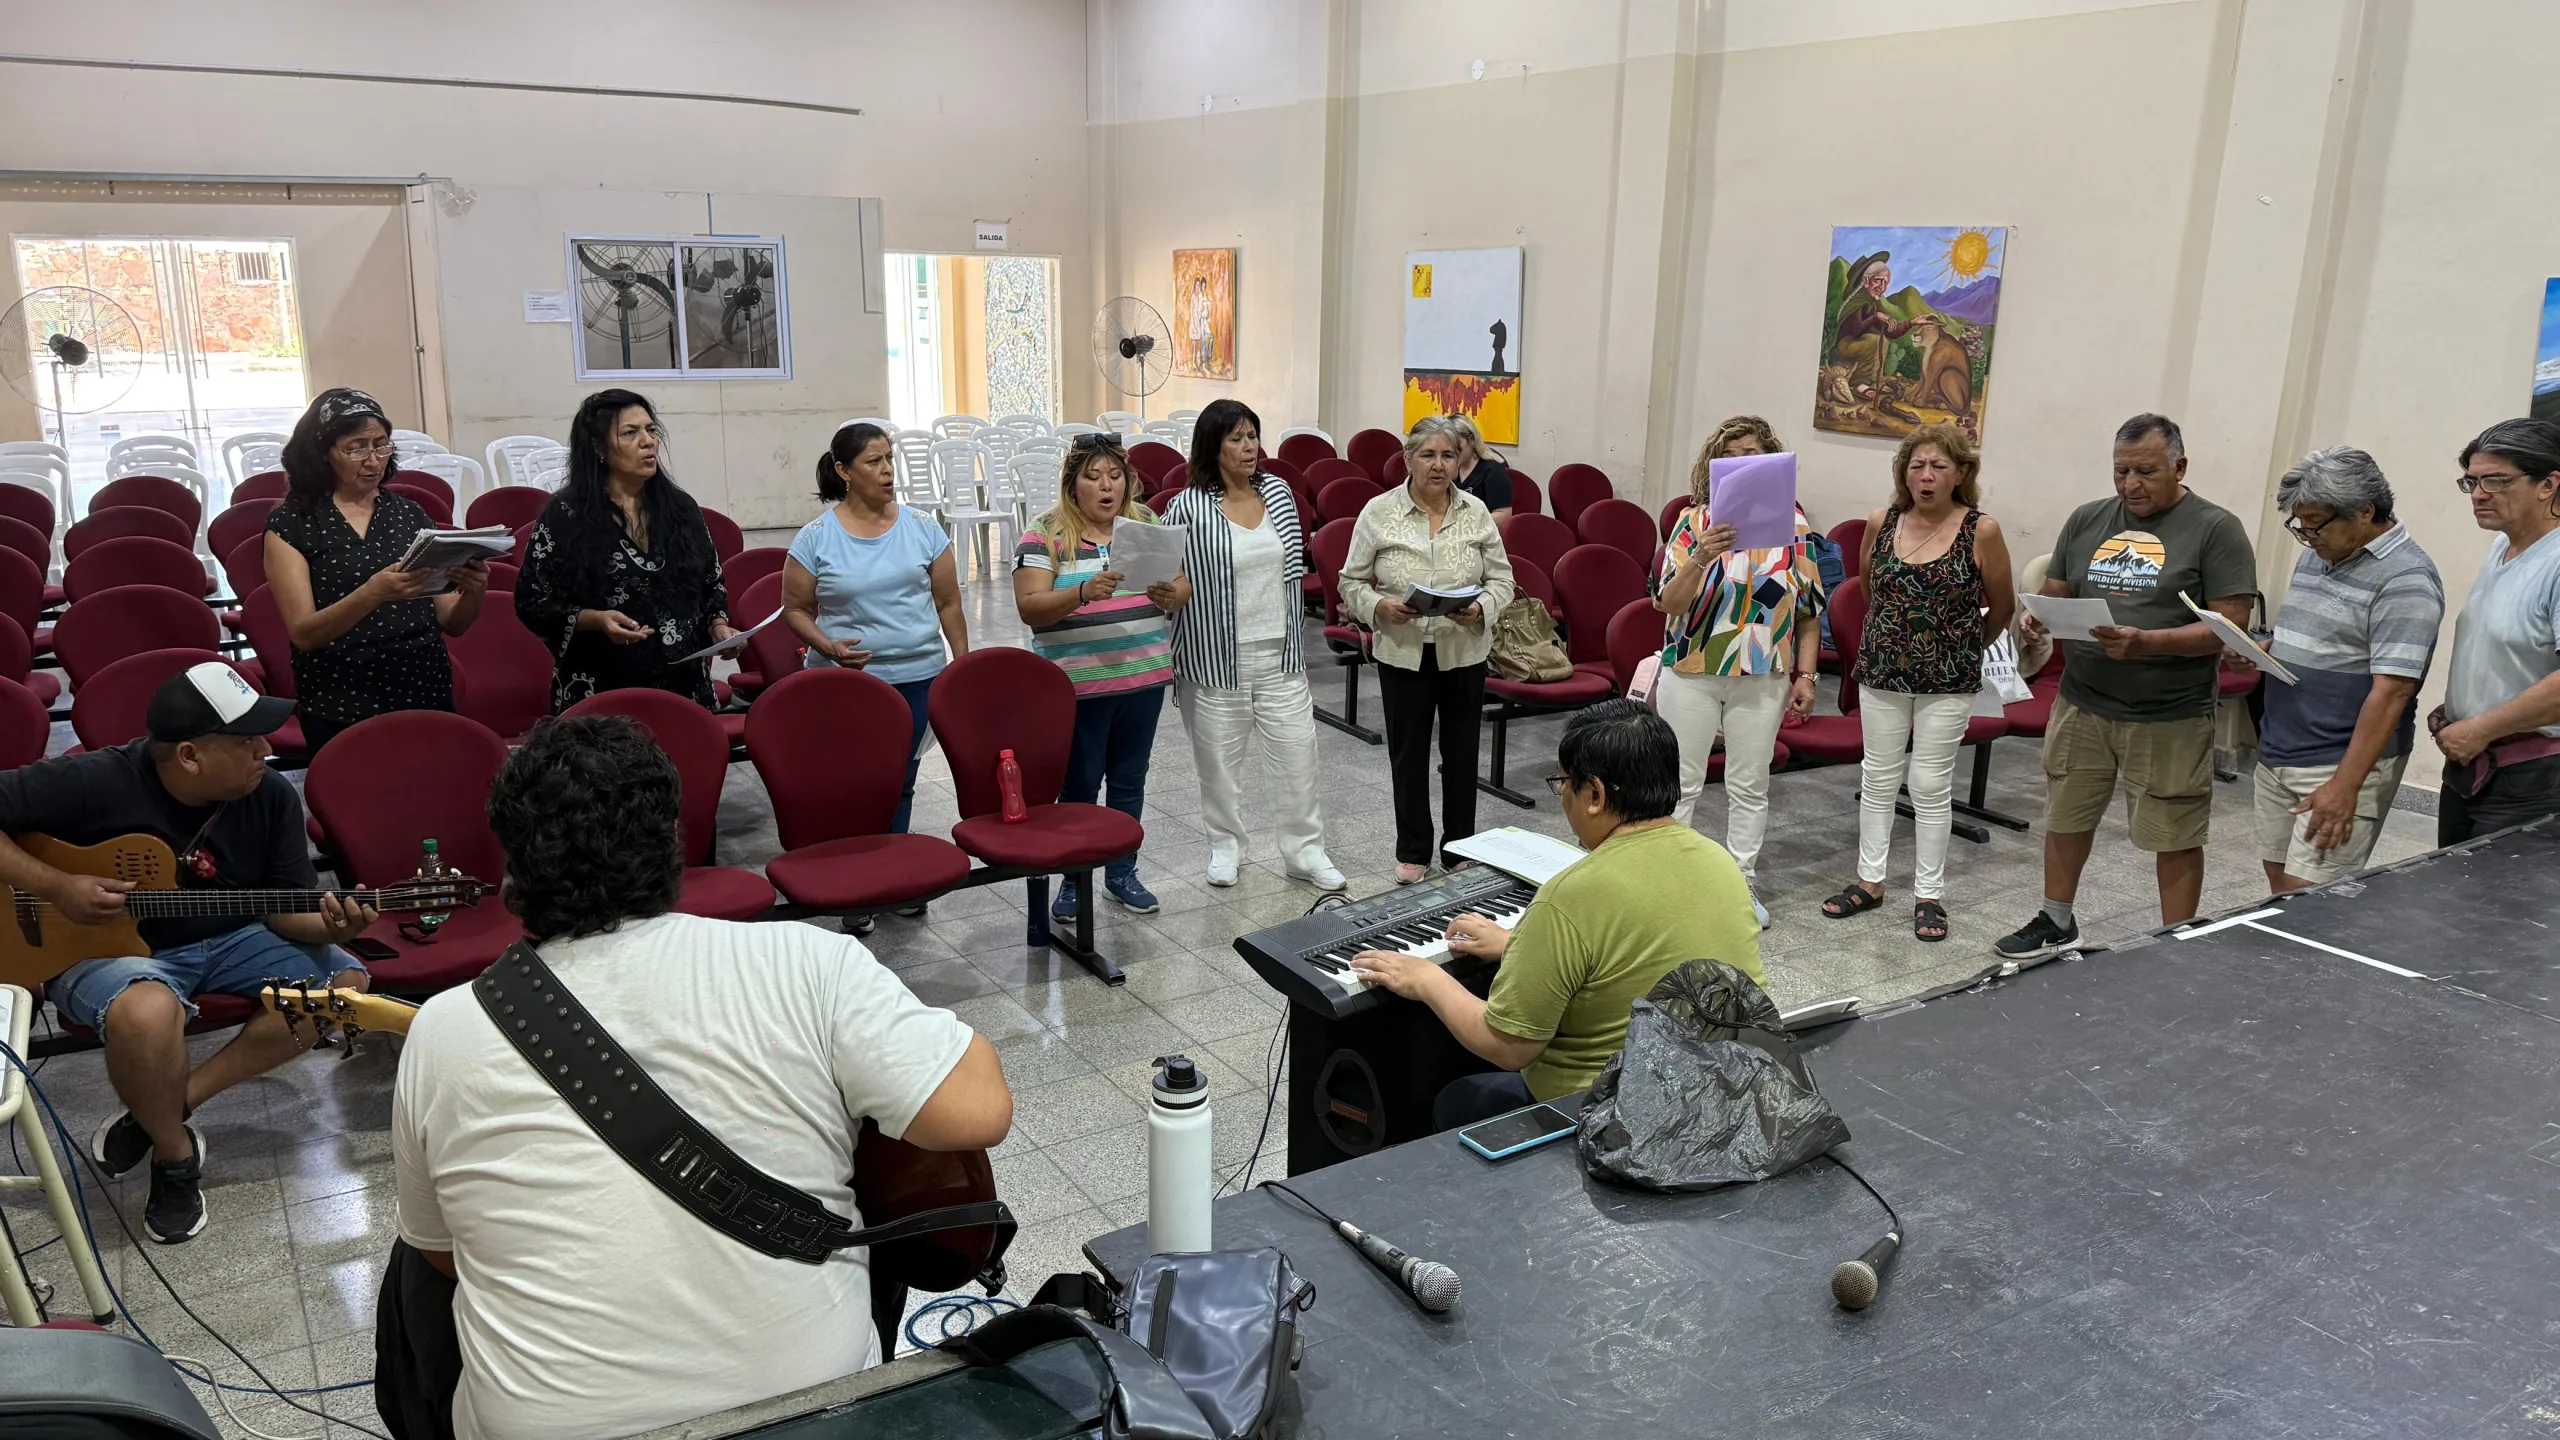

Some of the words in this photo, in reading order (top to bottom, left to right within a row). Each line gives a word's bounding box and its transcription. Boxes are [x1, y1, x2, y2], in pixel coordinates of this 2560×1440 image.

[2087, 573, 2122, 584] WILDLIFE
[2122, 578, 2158, 587] DIVISION
[1984, 666, 2009, 677] BLUE
